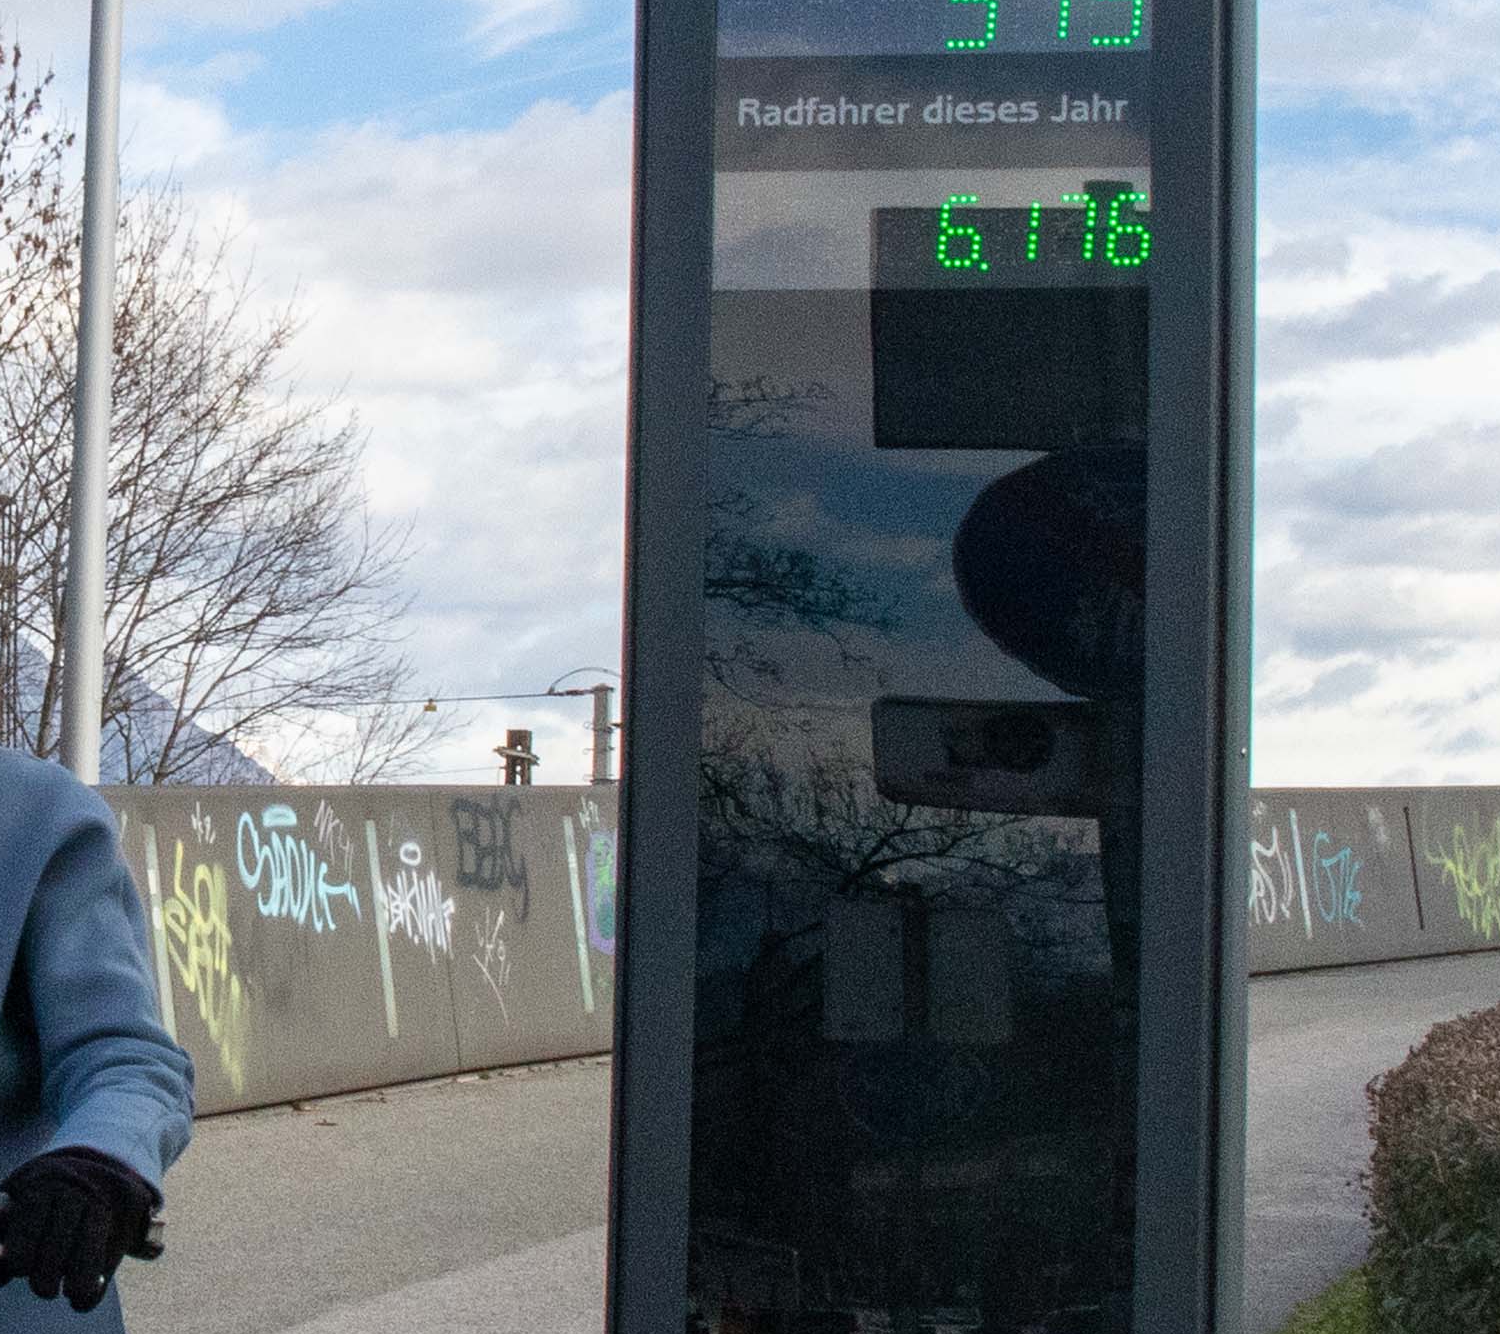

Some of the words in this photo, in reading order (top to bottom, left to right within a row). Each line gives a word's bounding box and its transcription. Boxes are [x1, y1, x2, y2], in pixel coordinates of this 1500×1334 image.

[737, 97, 911, 127] Radfahrer
[922, 94, 1040, 124] dieses
[1050, 93, 1129, 123] Jahr
